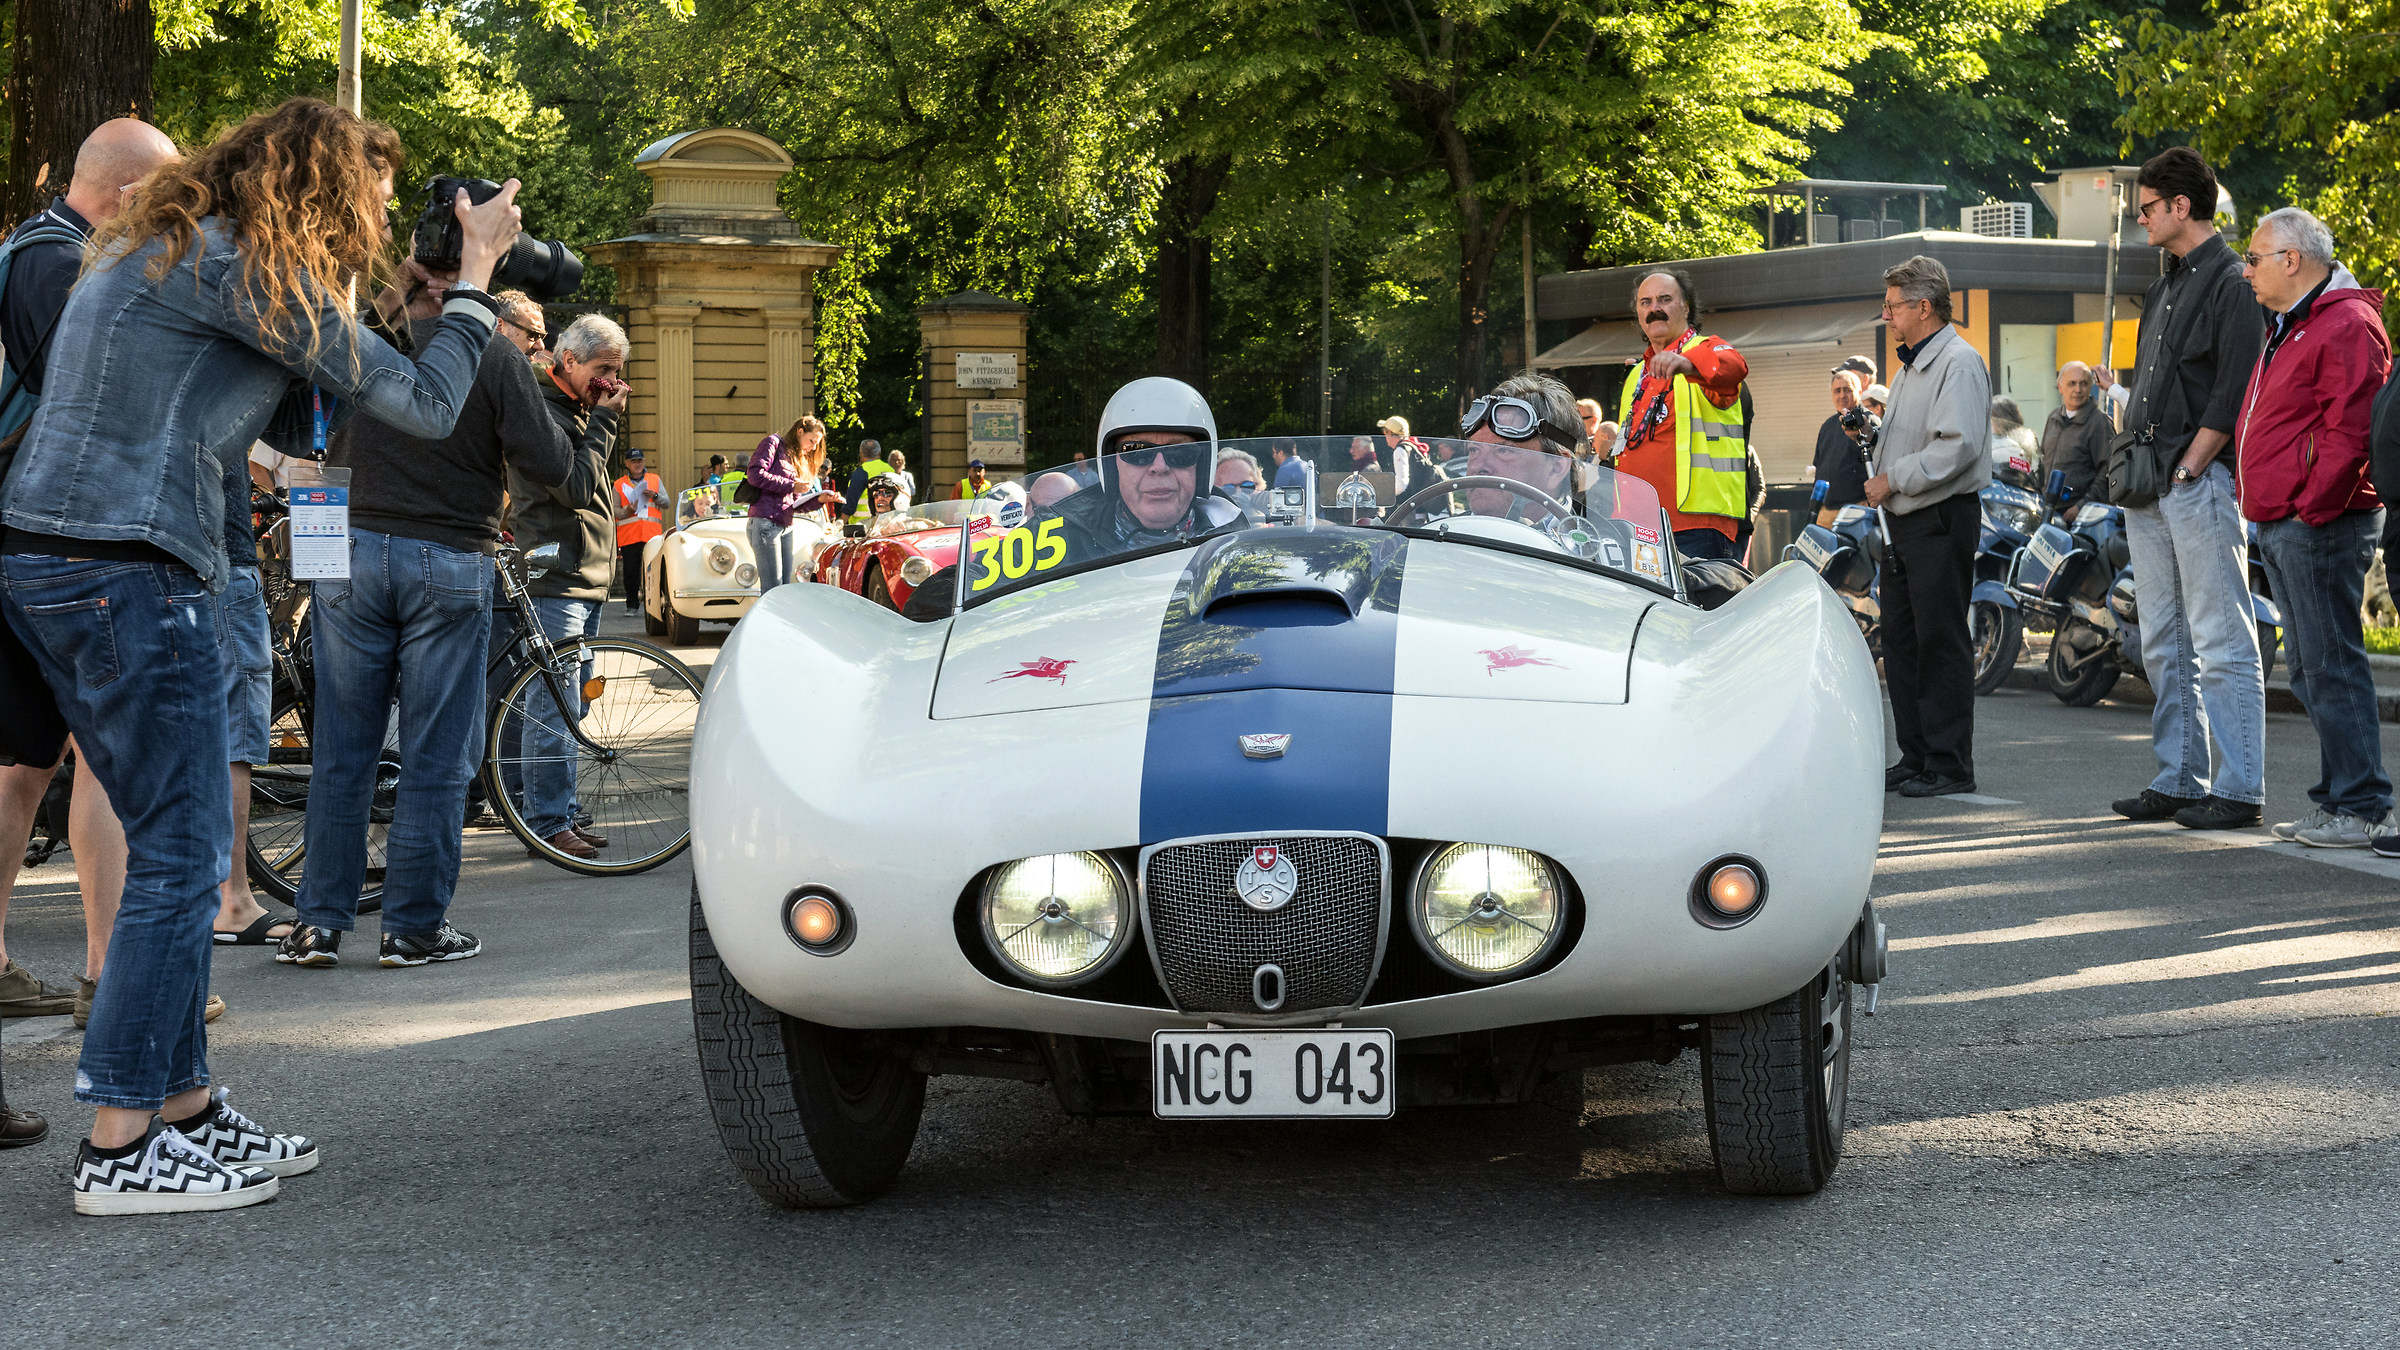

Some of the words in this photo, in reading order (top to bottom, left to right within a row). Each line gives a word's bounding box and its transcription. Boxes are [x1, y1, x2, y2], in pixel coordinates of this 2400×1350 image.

[981, 356, 993, 364] VIA
[958, 367, 973, 375] JOHN
[976, 367, 1016, 375] FITZGERALD
[972, 377, 1002, 385] KENNEDY
[687, 487, 711, 501] 311
[1000, 510, 1023, 522] VERIFICATO
[970, 518, 987, 527] 1000
[1638, 528, 1654, 536] 1000
[971, 516, 1067, 591] 305
[1162, 1042, 1252, 1105] NCG
[1295, 1042, 1385, 1105] 043
